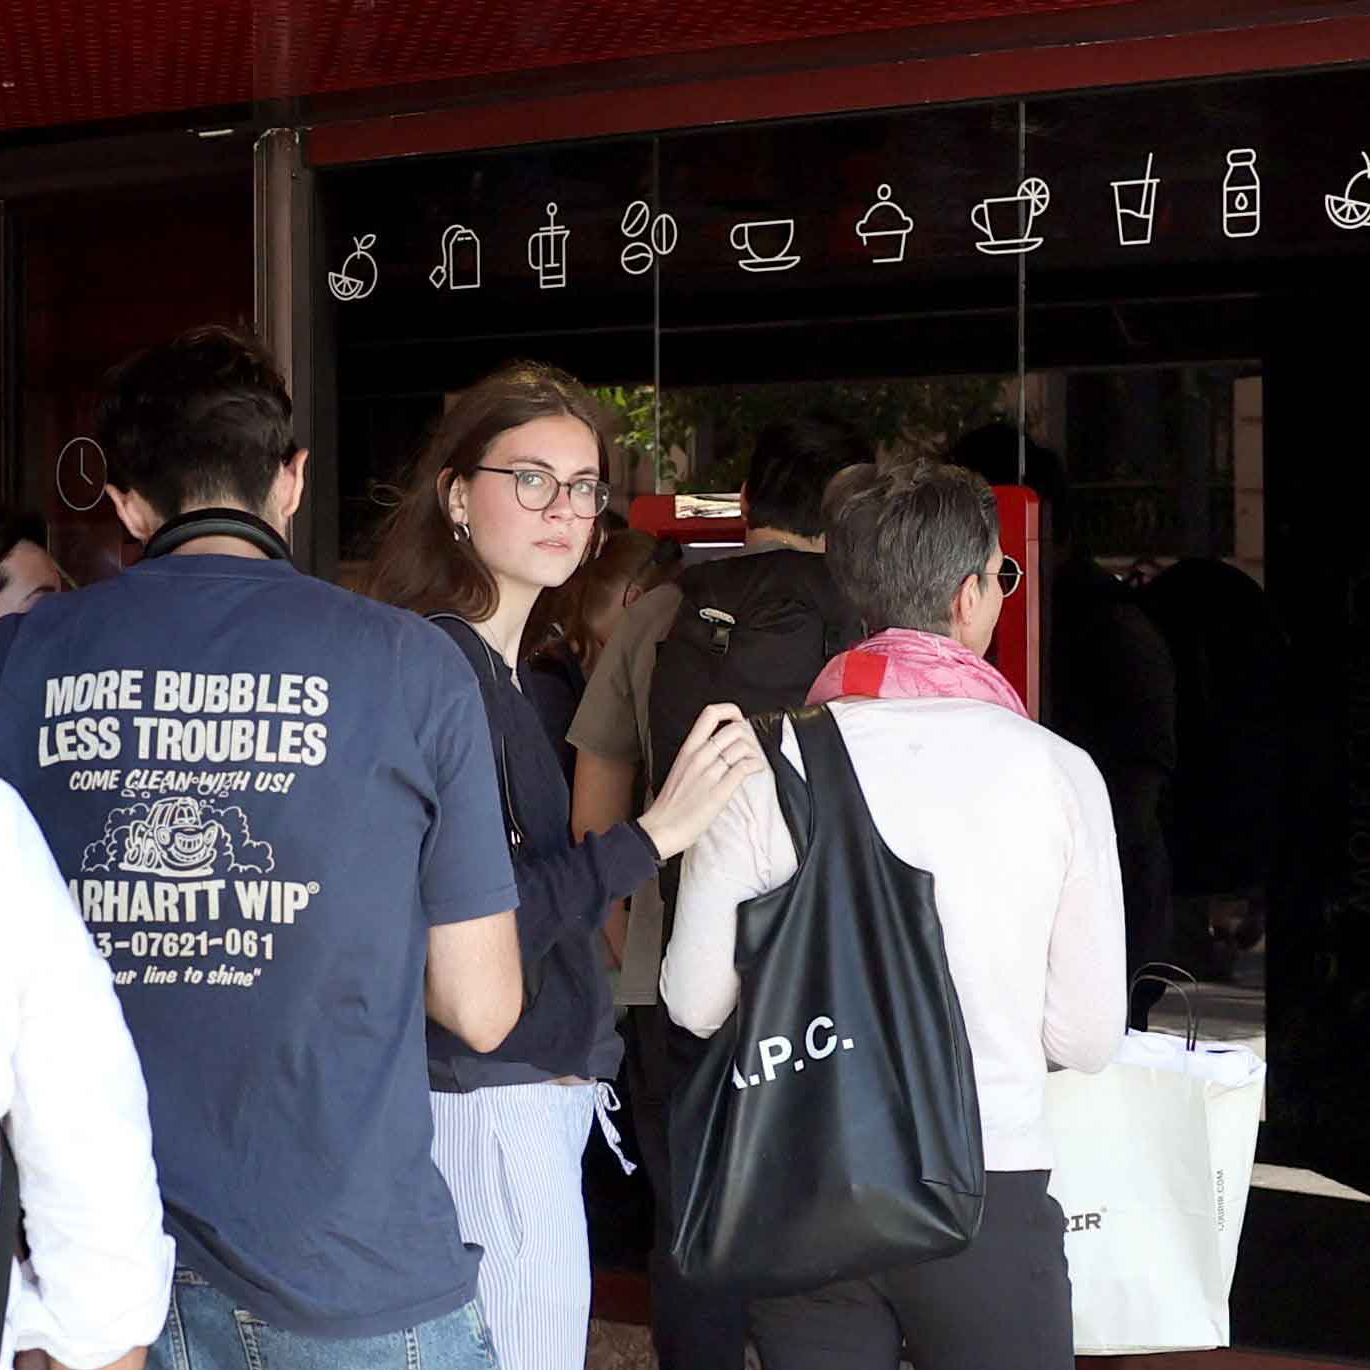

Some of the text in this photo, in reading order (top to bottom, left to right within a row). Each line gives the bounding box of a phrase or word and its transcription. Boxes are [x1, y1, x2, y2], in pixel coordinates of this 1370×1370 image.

[45, 670, 329, 719] MORE BUBBLES
[38, 716, 327, 767] LESS TROUBLES
[69, 769, 296, 794] COME CLEAN WITH US!
[143, 965, 177, 984] line
[184, 967, 202, 984] to
